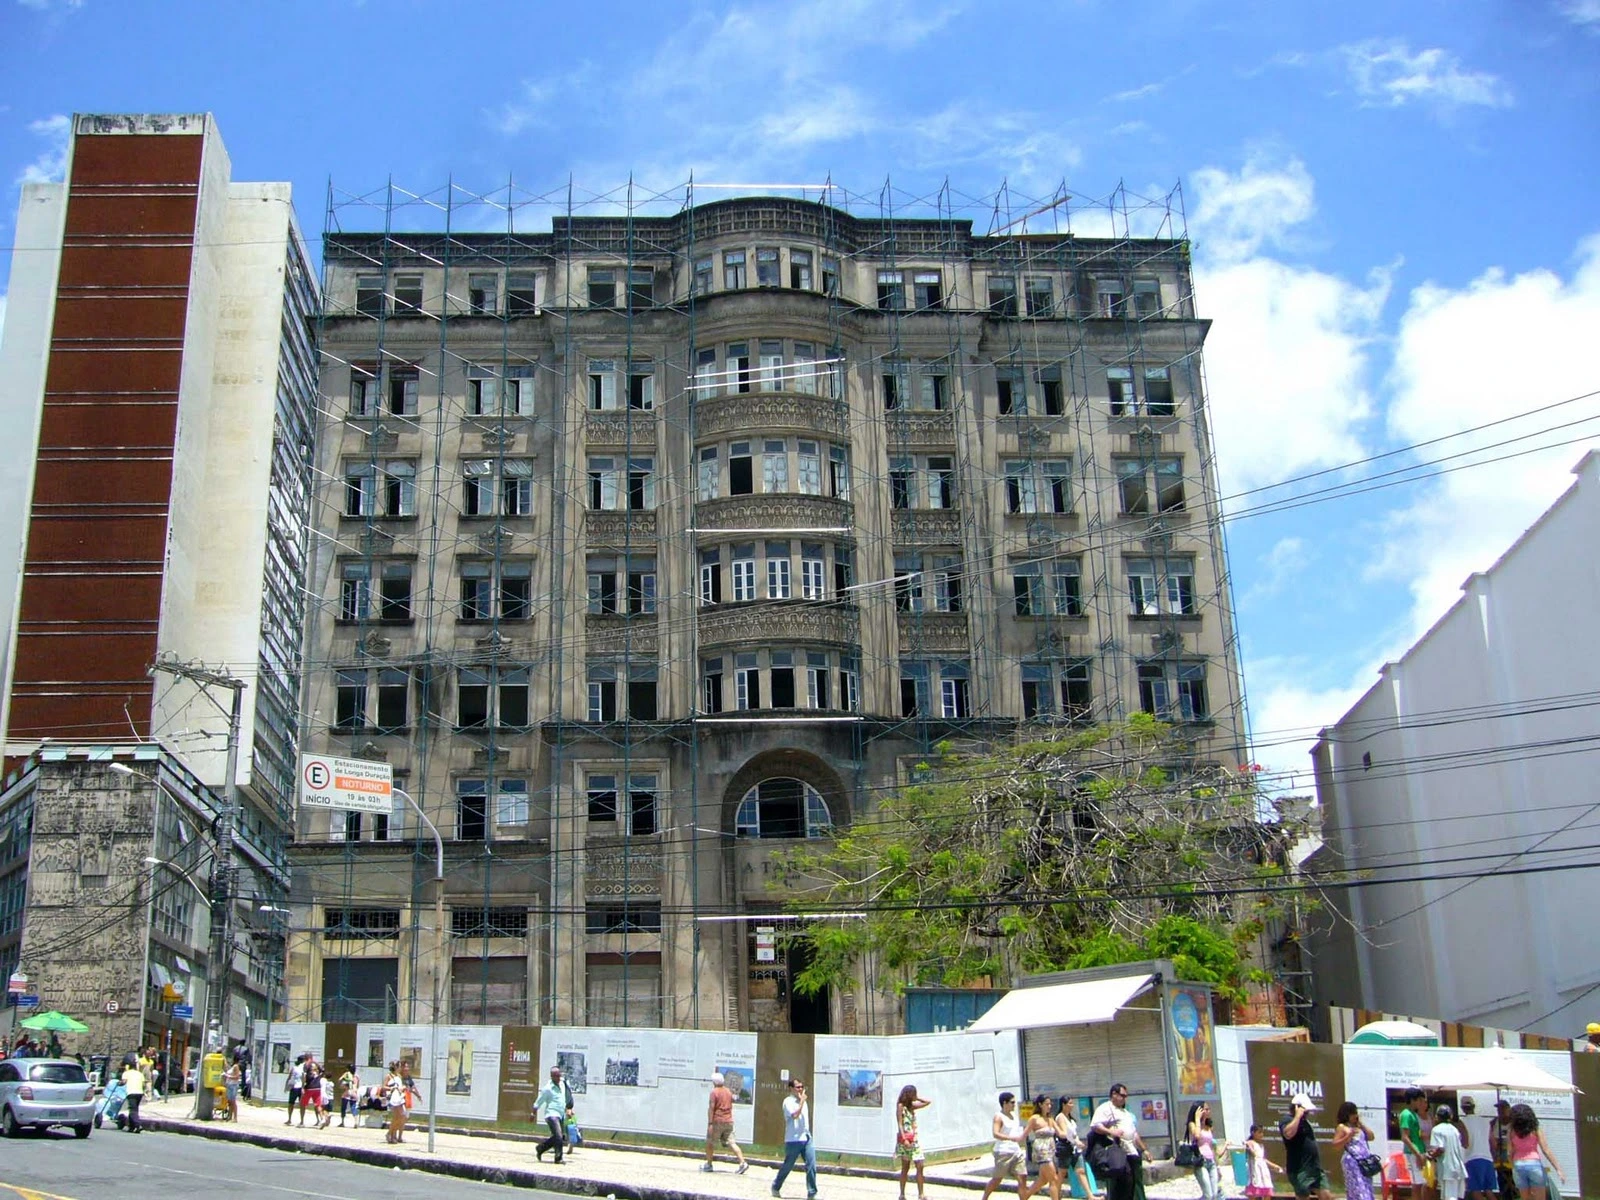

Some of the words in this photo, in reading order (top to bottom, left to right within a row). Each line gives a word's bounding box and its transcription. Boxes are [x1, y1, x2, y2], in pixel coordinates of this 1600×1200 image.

[335, 760, 388, 772] Estacionamento
[313, 767, 322, 783] E
[344, 768, 363, 777] Longa
[365, 771, 390, 780] Duração
[342, 780, 383, 792] NOTURNO
[306, 794, 330, 804] INÍCIO
[347, 793, 355, 801] 19
[513, 1050, 531, 1062] PRIMA
[1280, 1079, 1323, 1097] PRIMA
